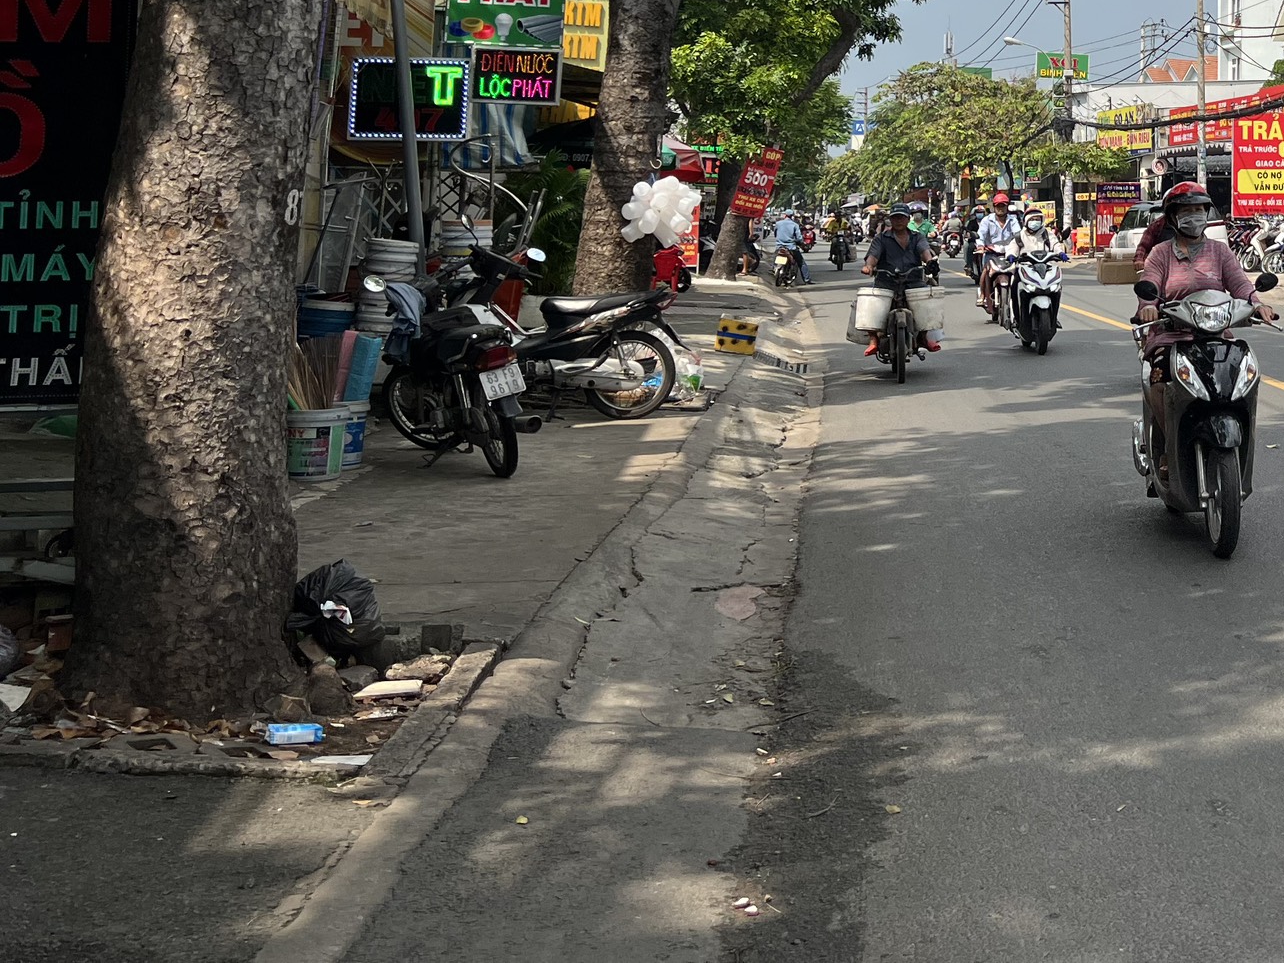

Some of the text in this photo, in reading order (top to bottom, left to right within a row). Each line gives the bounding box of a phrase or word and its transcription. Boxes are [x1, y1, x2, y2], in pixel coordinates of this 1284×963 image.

[478, 74, 553, 99] LỘC PHÁT
[1238, 113, 1284, 141] TRẢ
[1255, 159, 1274, 168] GIAO
[744, 171, 769, 187] 500
[1, 243, 97, 283] MÁY
[0, 303, 79, 340] TRỊ
